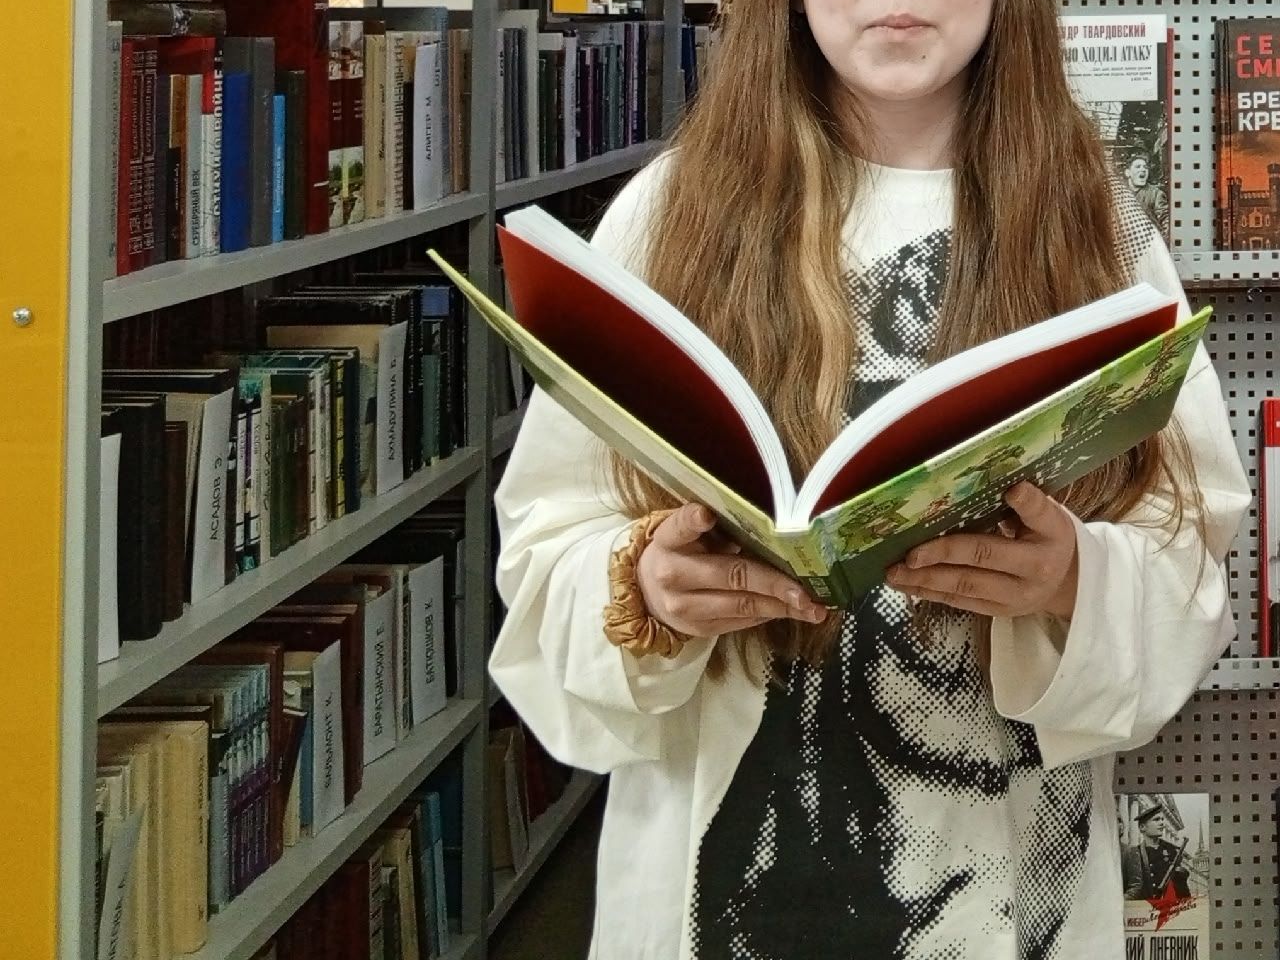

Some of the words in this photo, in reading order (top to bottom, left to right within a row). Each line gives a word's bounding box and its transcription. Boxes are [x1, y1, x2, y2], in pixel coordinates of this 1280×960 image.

[1082, 45, 1118, 66] ХОДИЛ
[1121, 44, 1152, 62] АТАКУ
[1083, 23, 1146, 40] ТВАРДОВСКИЙ
[424, 113, 432, 161] АЛИГЕР
[191, 169, 200, 186] ВЕК
[191, 188, 200, 246] СЕРЕБРЯНЫЙ
[388, 374, 397, 460] АХМАДУЛИНА
[210, 476, 221, 540] АСАДОВ
[424, 615, 436, 685] БАТЮШКОВ
[373, 640, 385, 737] БАРАТЫНСКИЙ
[324, 713, 333, 789] БАЛЬМОНТ
[1150, 935, 1199, 960] ДНЕВНИК
